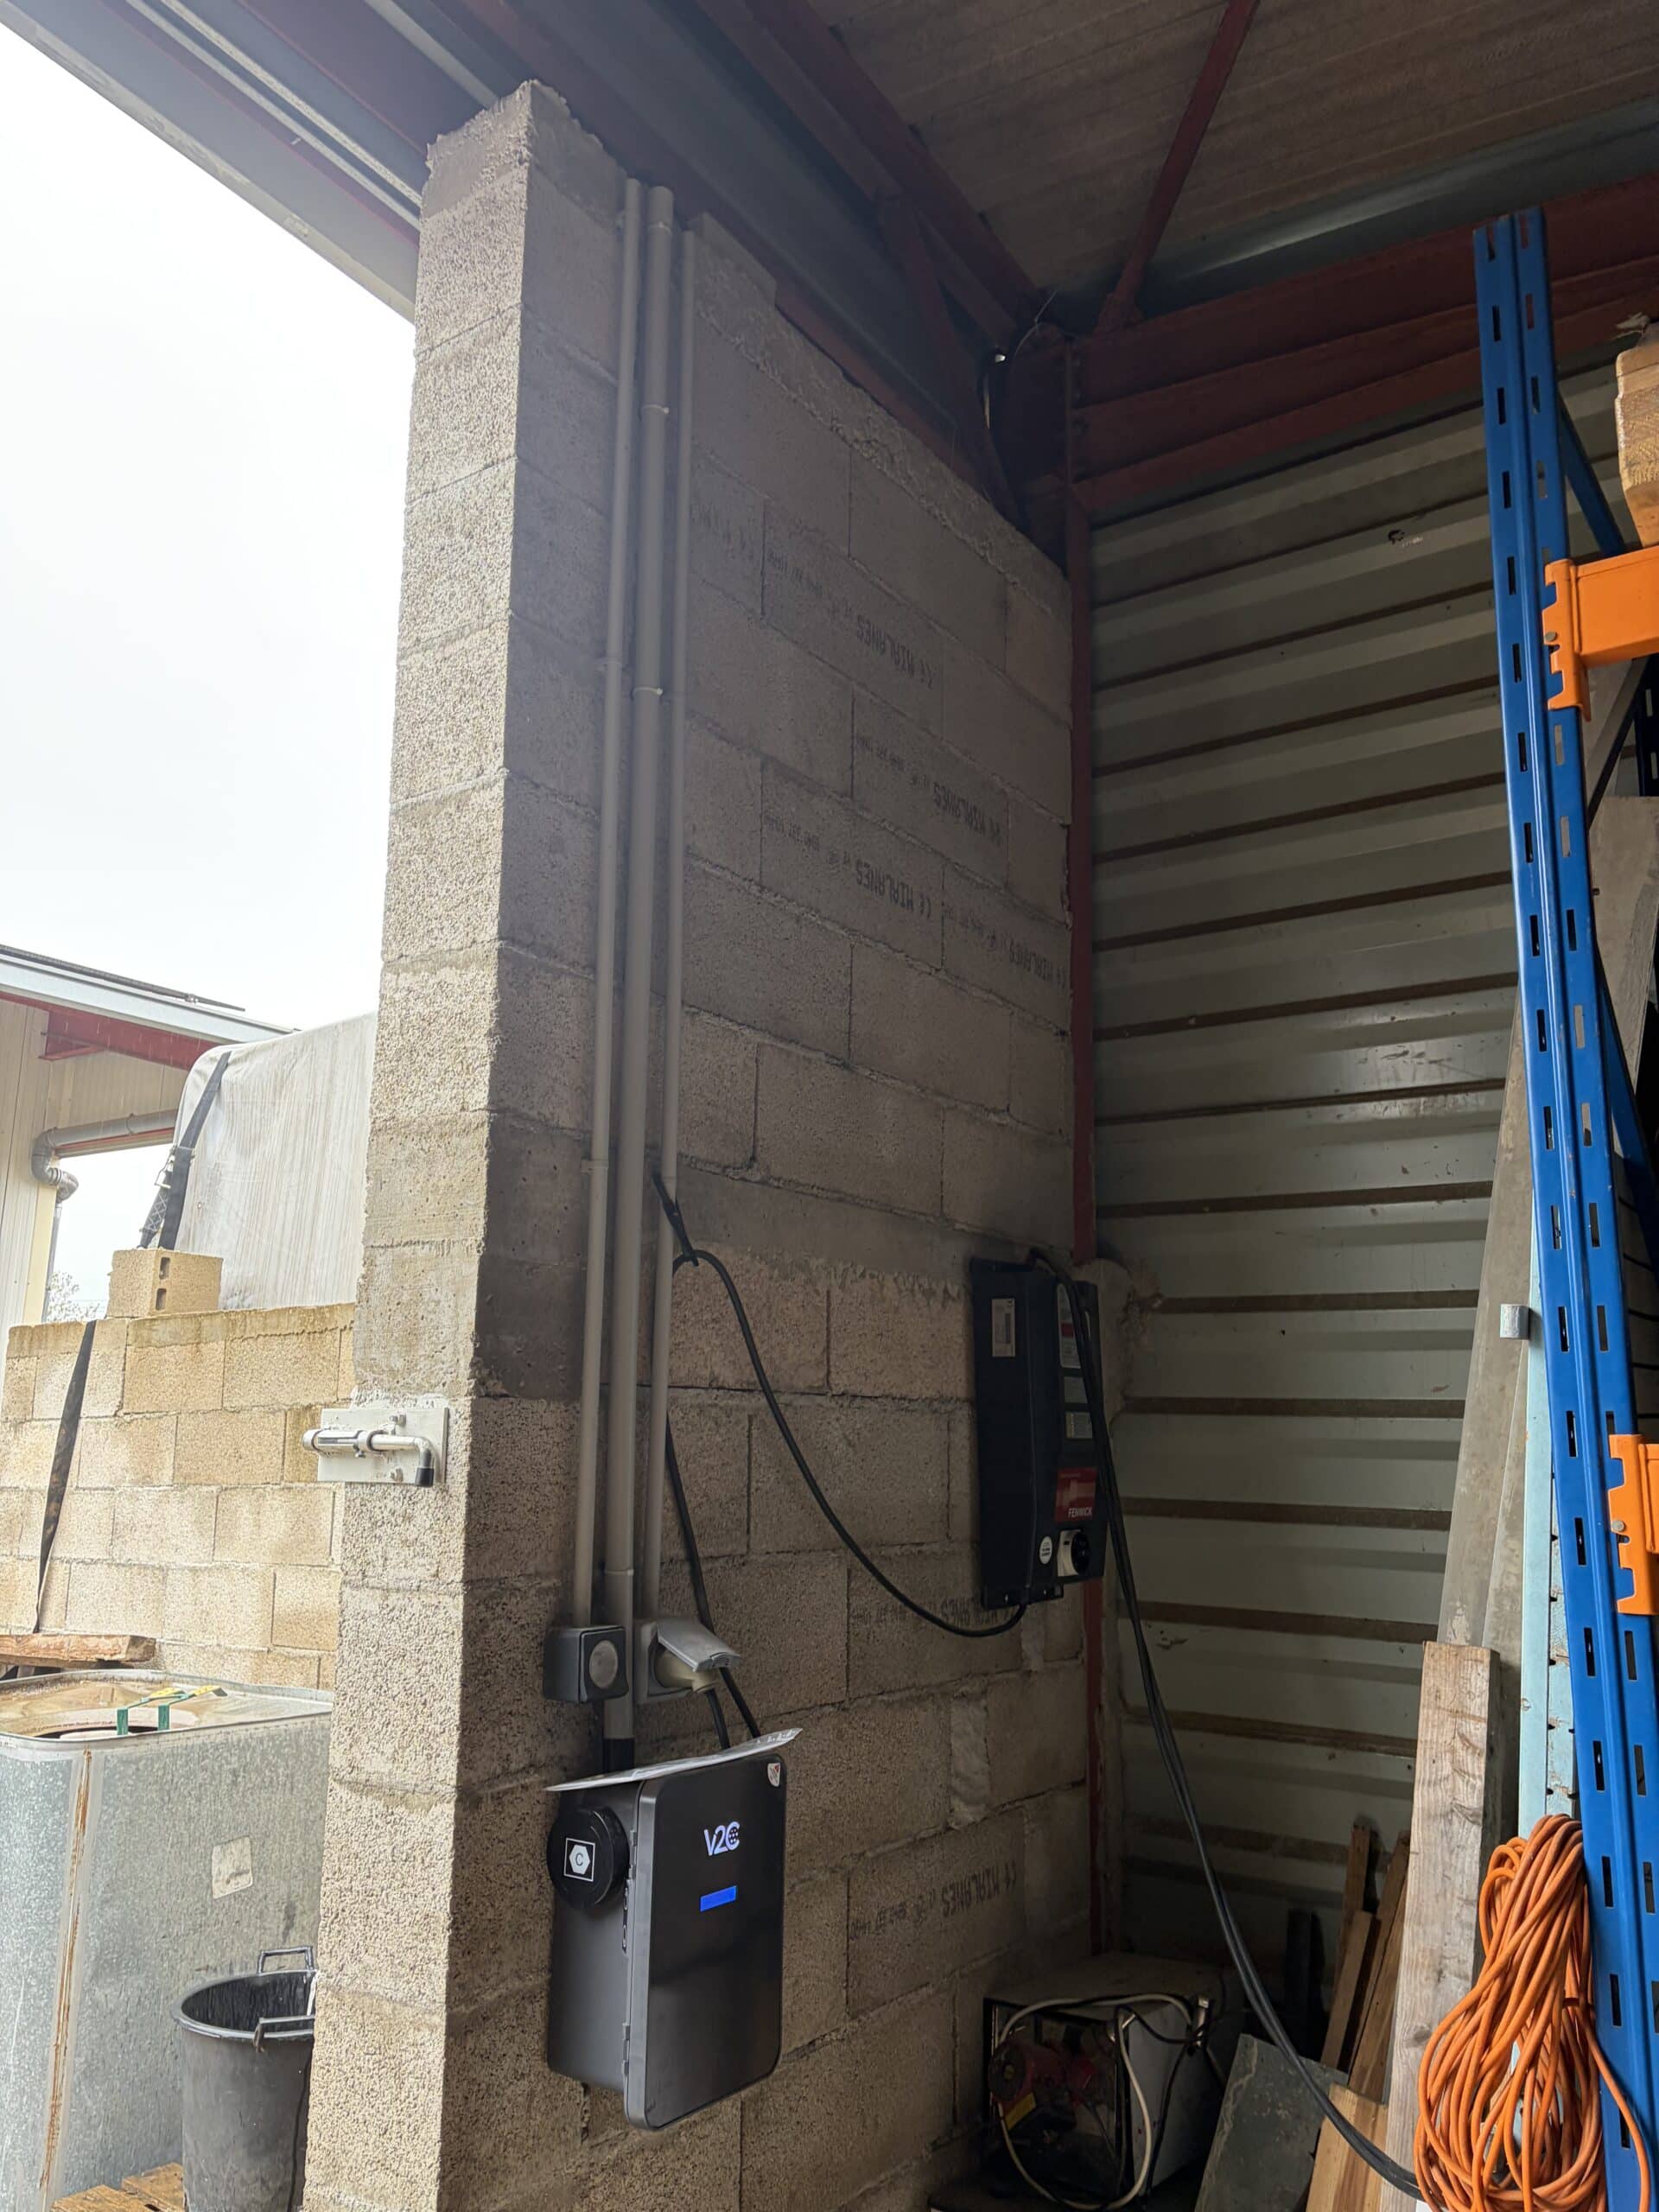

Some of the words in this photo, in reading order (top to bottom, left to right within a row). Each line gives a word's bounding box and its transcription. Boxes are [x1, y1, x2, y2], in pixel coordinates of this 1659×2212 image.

[855, 859, 914, 913] MIALANES
[1067, 1506, 1094, 1519] FENWICK
[702, 1820, 741, 1858] V2C
